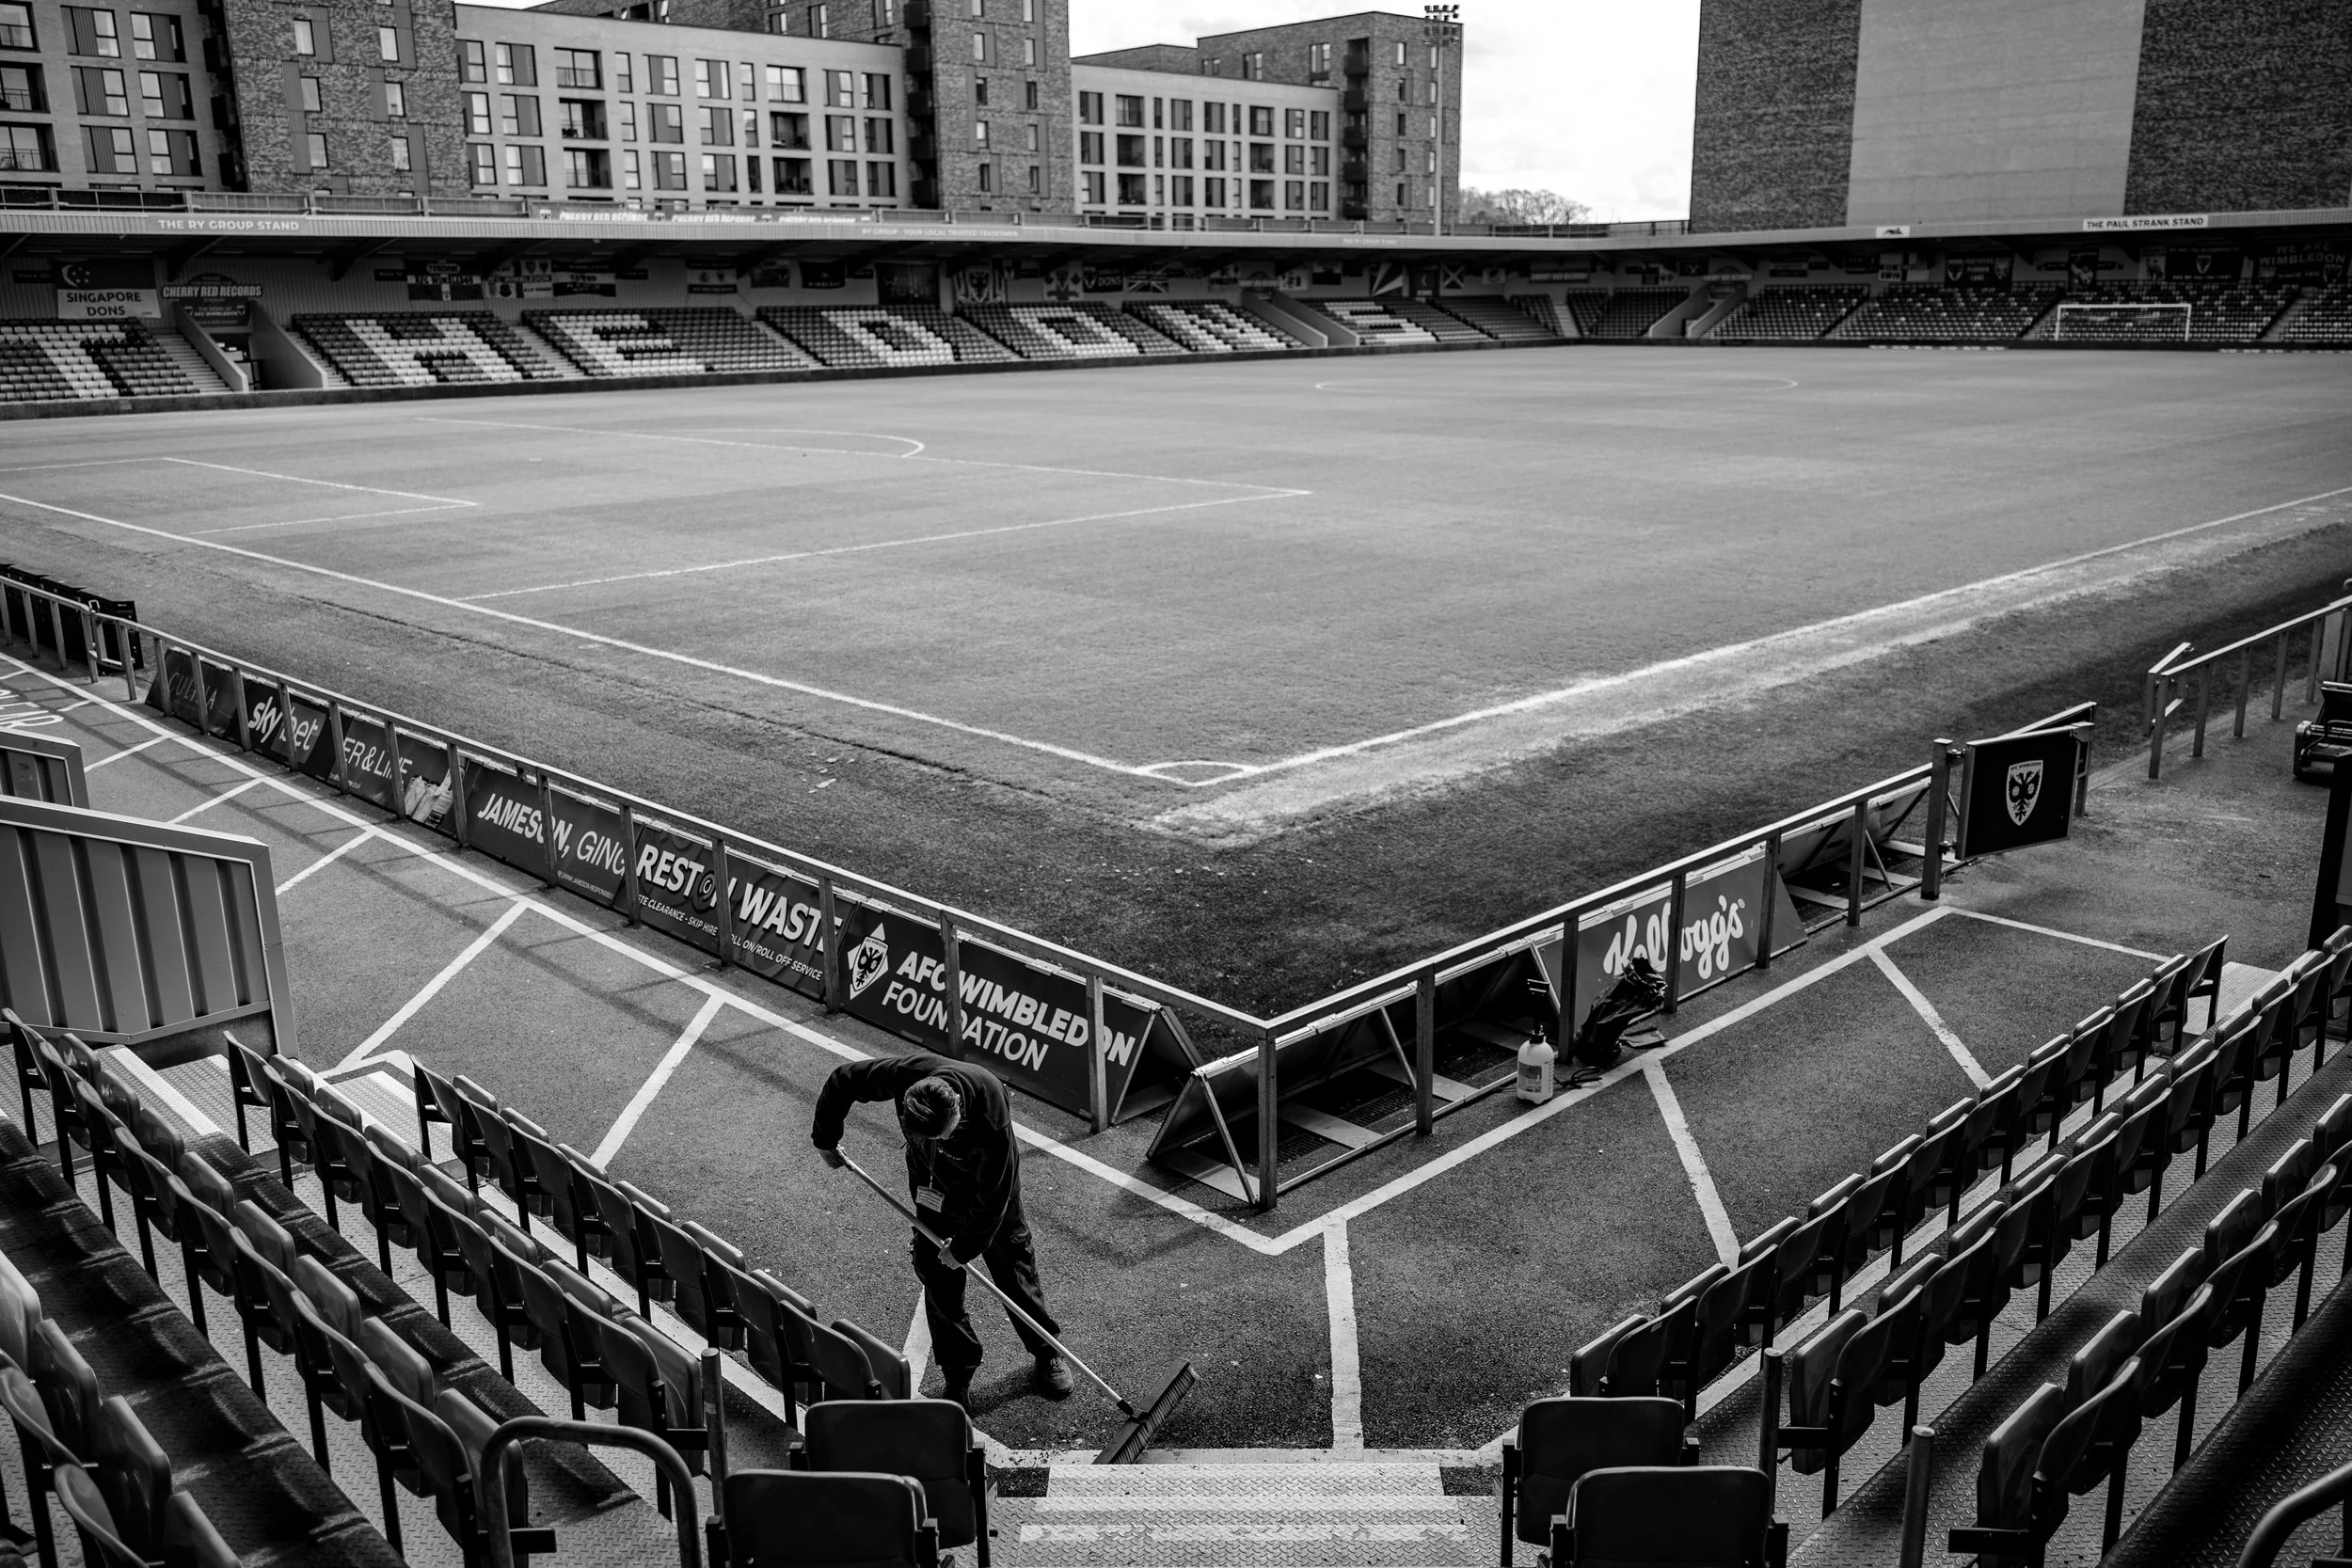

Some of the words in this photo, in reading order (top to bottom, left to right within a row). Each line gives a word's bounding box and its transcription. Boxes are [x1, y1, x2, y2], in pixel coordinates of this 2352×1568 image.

[158, 219, 185, 230] THE
[188, 220, 206, 230] RY
[210, 220, 255, 230] GROUP
[258, 221, 299, 231] STAND
[2087, 221, 2105, 230] THE
[2106, 220, 2129, 229] PAUL
[2132, 219, 2169, 229] STRANK
[2172, 217, 2204, 227] STAND
[2276, 245, 2297, 255] WE
[2259, 252, 2346, 266] WIMBLEDON
[163, 286, 200, 297] CHERRY
[200, 286, 219, 297] RED
[220, 285, 262, 297] RECORDS
[67, 292, 142, 303] SINGAPORE
[87, 306, 126, 316] DONS
[168, 672, 217, 710] CULIA
[247, 696, 285, 743] sky
[572, 878, 590, 890] JAMESON
[647, 899, 686, 922] CLEARANCE
[688, 916, 704, 929] SKIP
[702, 923, 719, 937] HIRE
[742, 940, 775, 960] ON/ROLL
[775, 954, 792, 967] OFF
[790, 960, 823, 981] SERVICE
[896, 950, 946, 991] AFC
